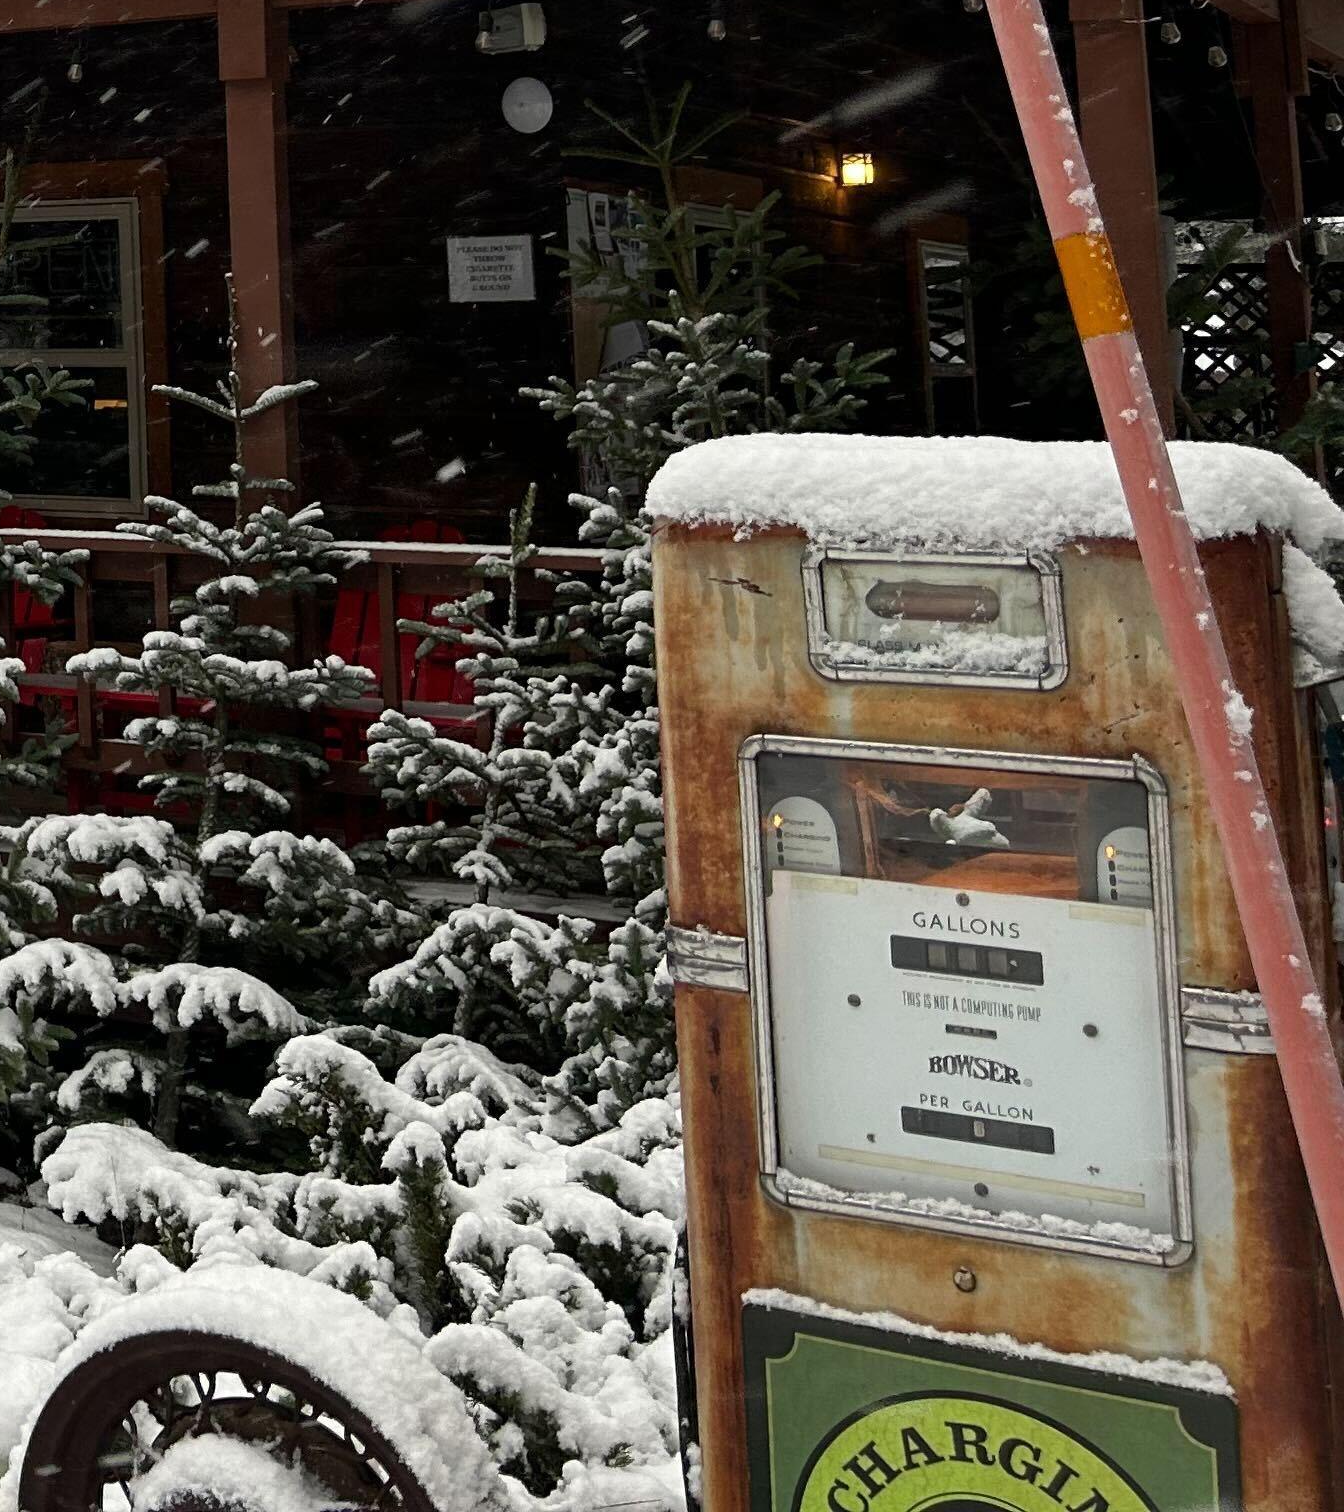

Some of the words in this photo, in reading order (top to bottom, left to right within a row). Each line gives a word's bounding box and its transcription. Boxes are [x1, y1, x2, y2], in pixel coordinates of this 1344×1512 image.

[912, 911, 1021, 939] GALLONS
[902, 990, 922, 1009] THIS
[923, 993, 932, 1010] IS
[933, 994, 950, 1012] NOT
[952, 996, 959, 1014] A
[961, 997, 1014, 1020] COMPUTING
[1015, 1004, 1042, 1023] PUMP
[928, 1054, 1021, 1085] BOWSER
[919, 1093, 949, 1109] PER
[961, 1099, 1034, 1121] GALLON
